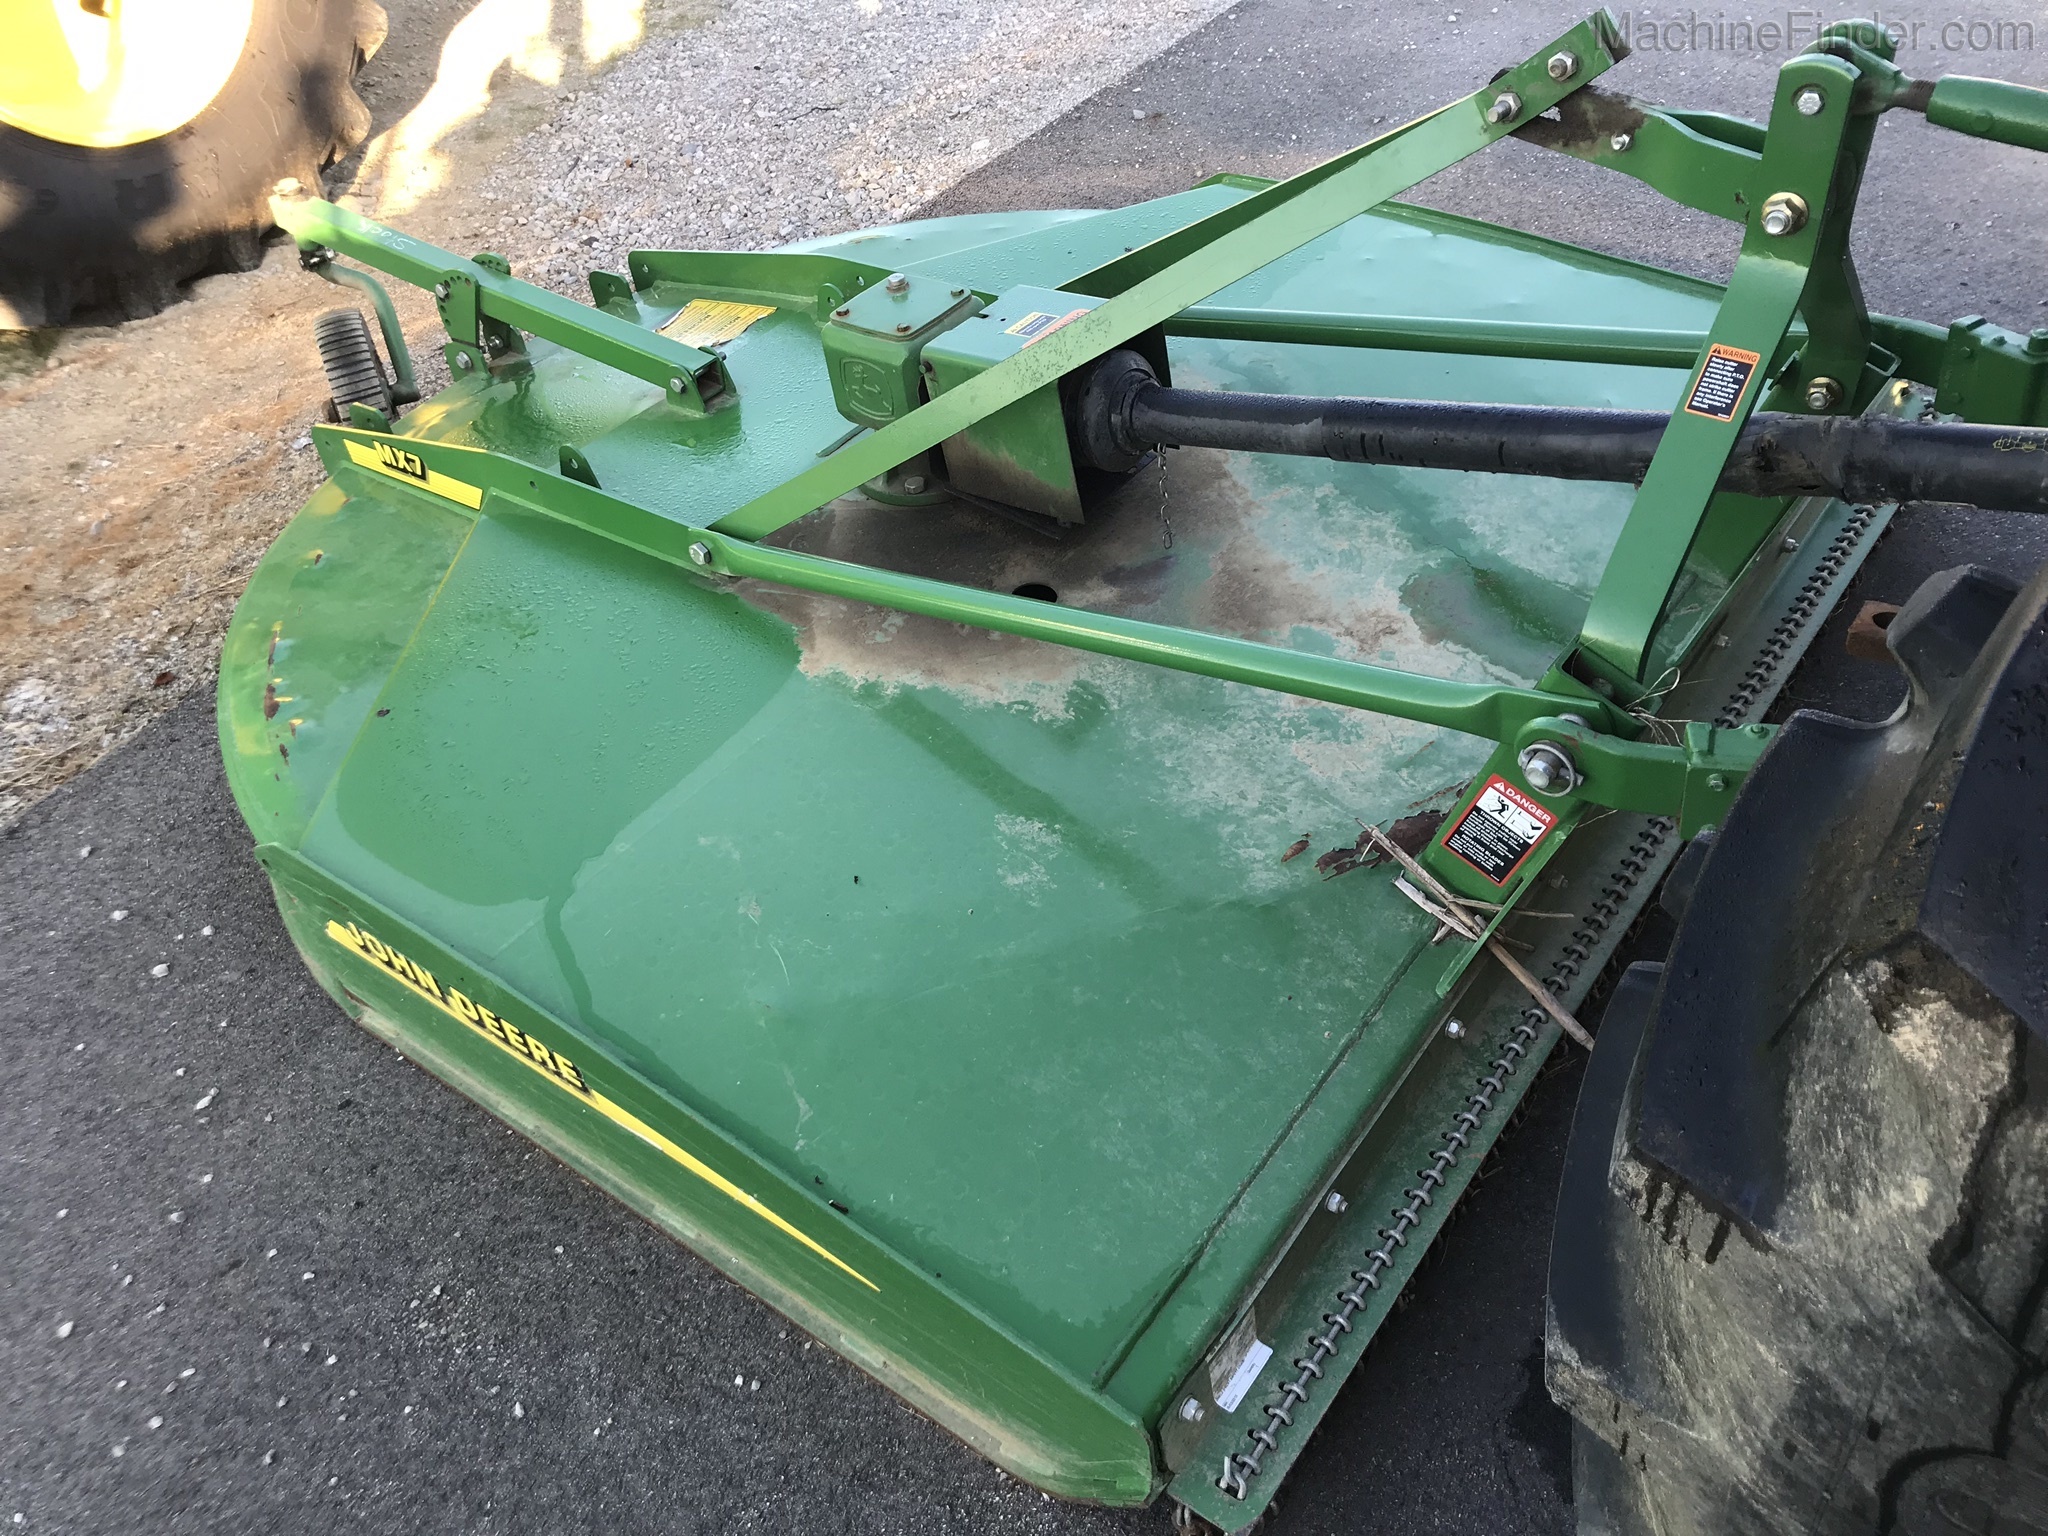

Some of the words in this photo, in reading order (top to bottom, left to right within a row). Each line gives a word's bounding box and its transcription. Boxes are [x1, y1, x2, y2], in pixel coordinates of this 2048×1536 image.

[1721, 348, 1758, 362] WARNING
[373, 440, 428, 482] MX7
[1504, 786, 1552, 823] DANGER
[1479, 810, 1501, 827] THROWN
[1500, 825, 1524, 844] OBJECTS
[1461, 833, 1485, 852] ROTATING
[1484, 850, 1504, 866] BLADES
[345, 921, 442, 998] JOHN
[450, 986, 590, 1094] DEERE
